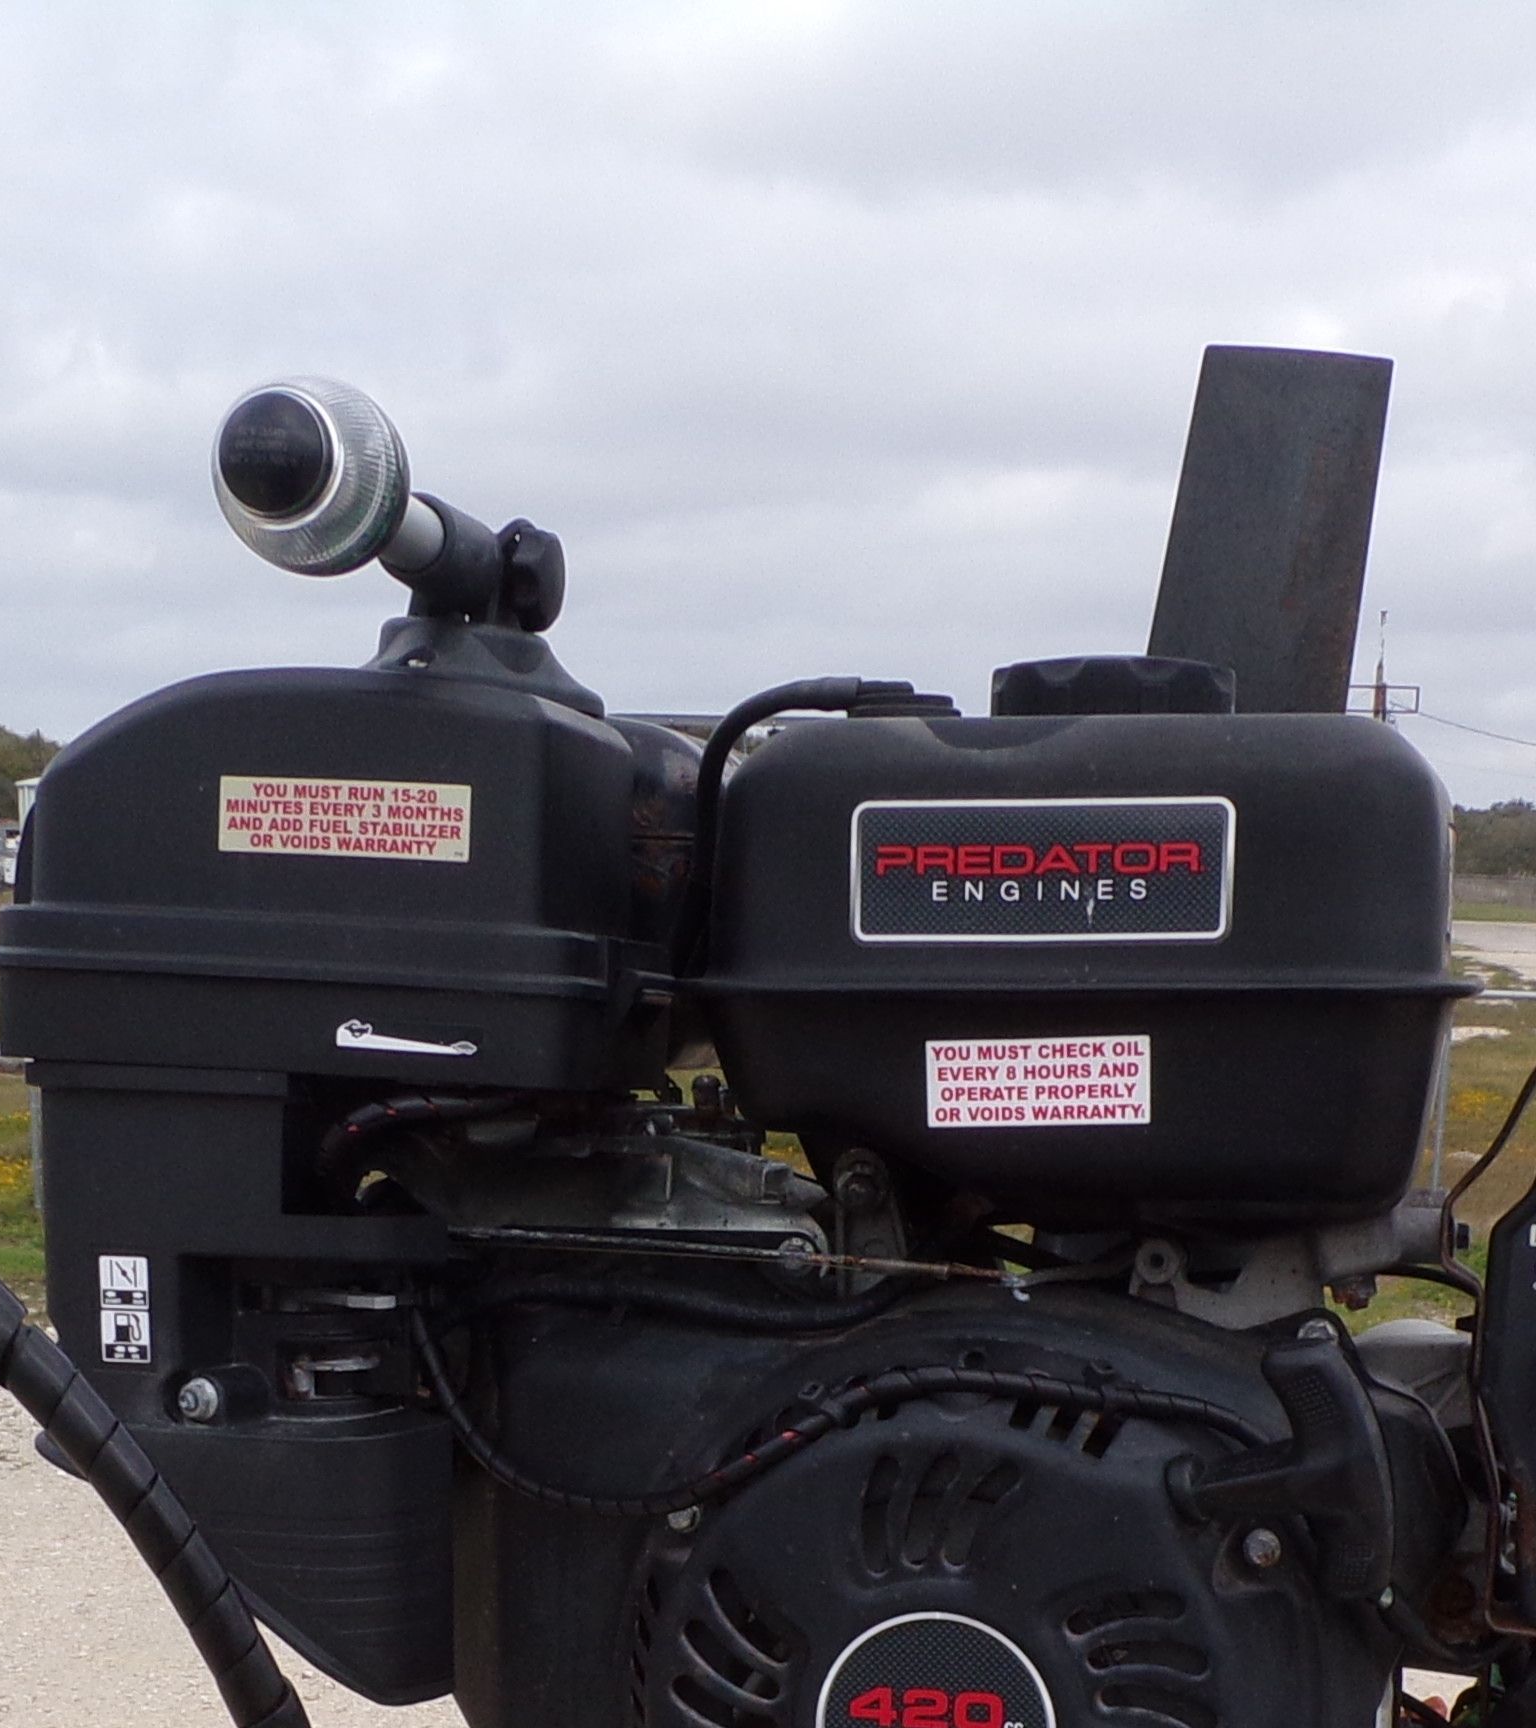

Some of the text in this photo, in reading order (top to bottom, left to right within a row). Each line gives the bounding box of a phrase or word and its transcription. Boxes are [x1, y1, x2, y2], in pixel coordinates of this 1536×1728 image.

[252, 783, 438, 804] YOU MUST RUN 15-20
[226, 799, 464, 823] MINUTES EVERY 3 MONTHS
[227, 816, 461, 840] AND ADD FUEL STABILIZER
[250, 833, 274, 848] OR
[279, 834, 331, 850] VOIDS
[336, 836, 437, 855] WARRANTY
[875, 843, 1202, 876] PREDATOR
[931, 878, 1148, 902] ENGINES
[931, 1041, 1145, 1061] YOU MUST CHECK OIL
[937, 1062, 1139, 1082] EVERY 8 HOURS AND
[940, 1083, 1137, 1102] OPERATE PROPERLY
[935, 1107, 962, 1122] OR
[967, 1106, 1026, 1122] VOIDS
[1032, 1104, 1143, 1121] WARRANTY
